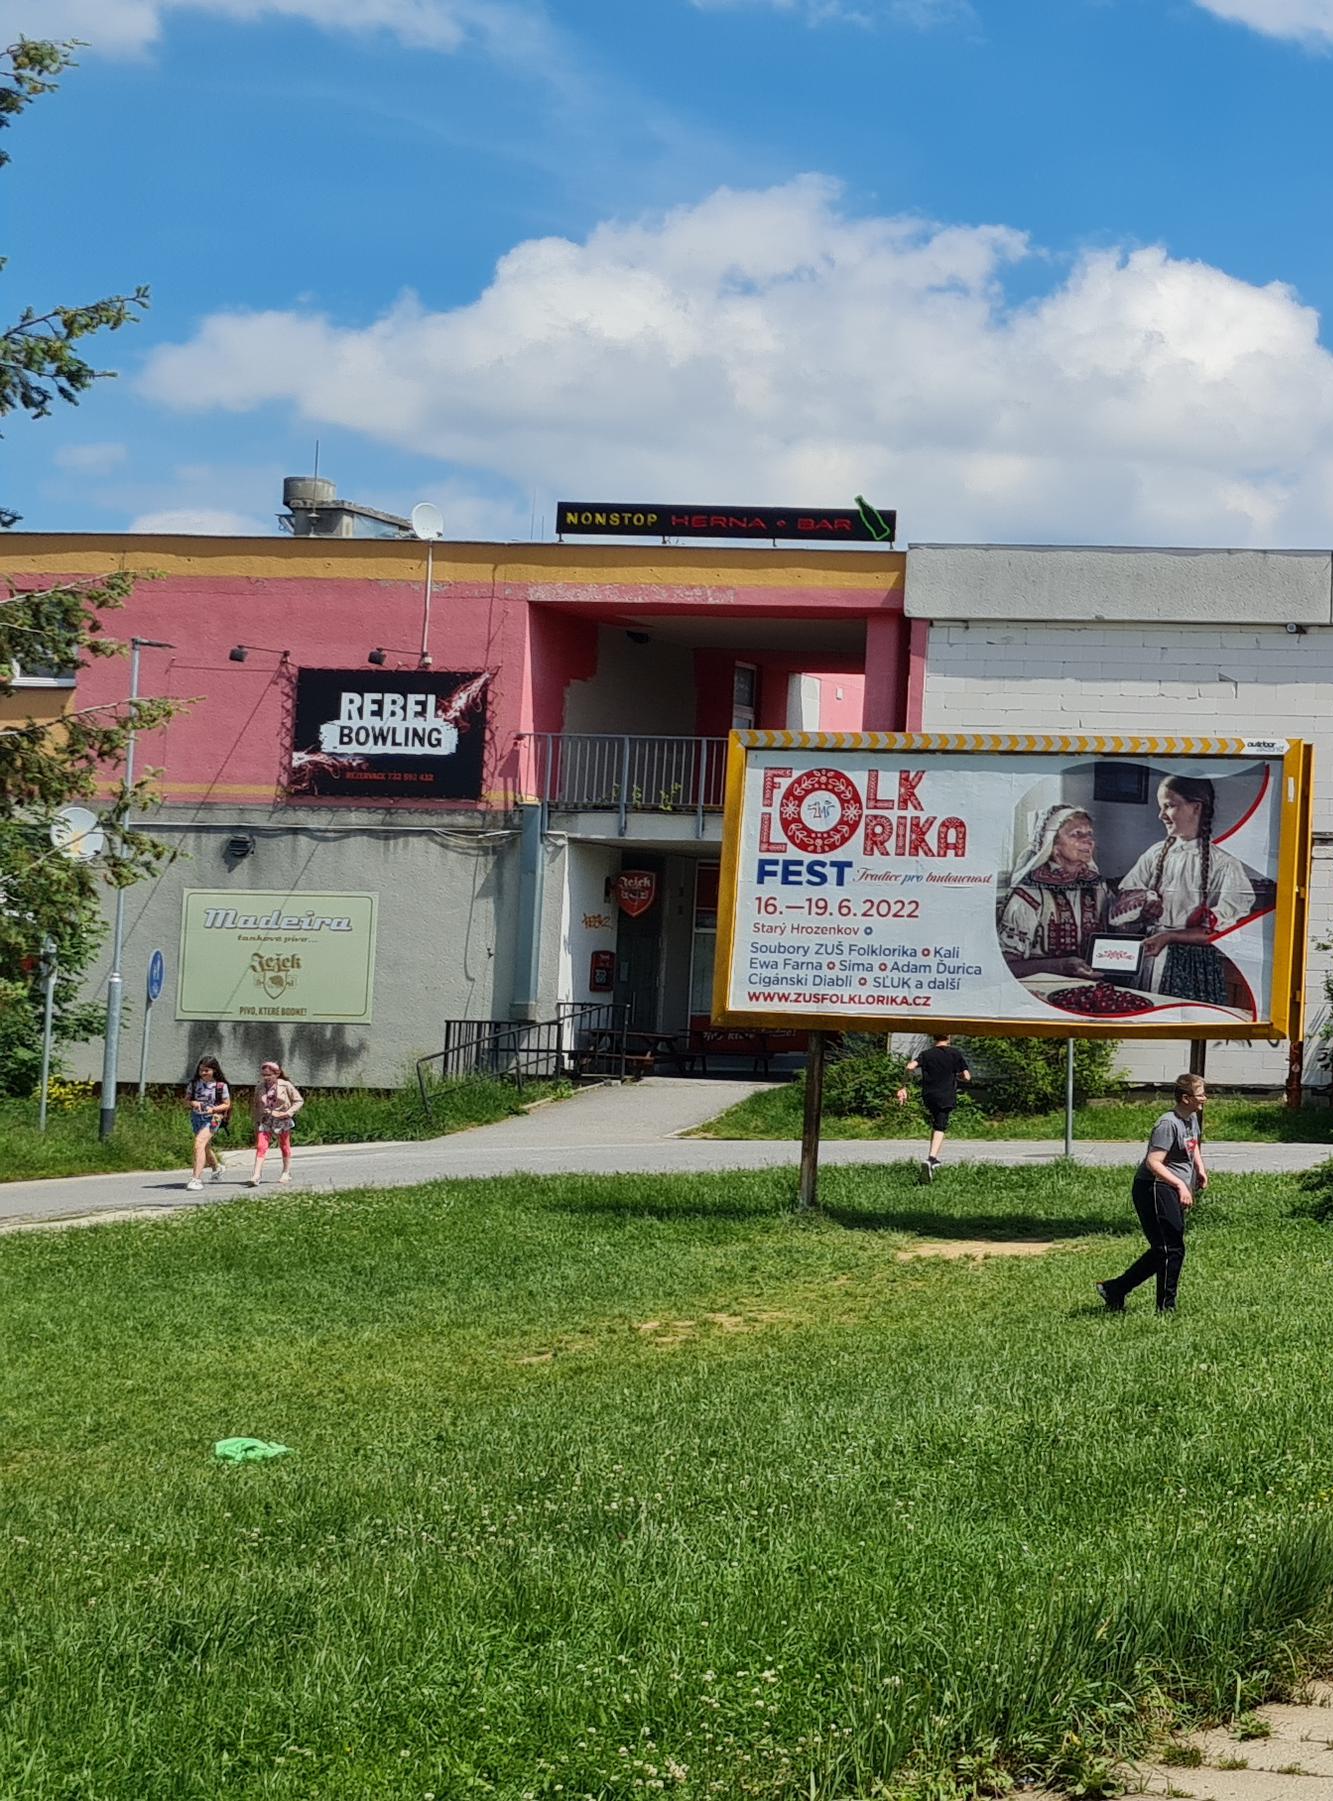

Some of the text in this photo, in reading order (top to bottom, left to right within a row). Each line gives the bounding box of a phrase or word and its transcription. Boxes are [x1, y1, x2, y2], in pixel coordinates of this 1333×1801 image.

[566, 511, 852, 531] NONSTOP HERNA BAR
[340, 692, 442, 721] REBEL
[339, 725, 442, 748] BOWLING
[756, 858, 853, 886] FEST
[901, 873, 922, 885] pro
[204, 908, 352, 931] Madeira
[752, 922, 860, 936] Starý Hrozenkov
[750, 941, 960, 959] Soubory ZUŠ Folklorika Kali
[250, 952, 302, 973] Ježek
[749, 957, 982, 975] Ewa Farna Sima Adam Ďurica
[748, 973, 960, 990] Cigánski Diabli SĽUK a další
[747, 991, 931, 1007] WWW.ZUSFOLKLORIKA.CZ
